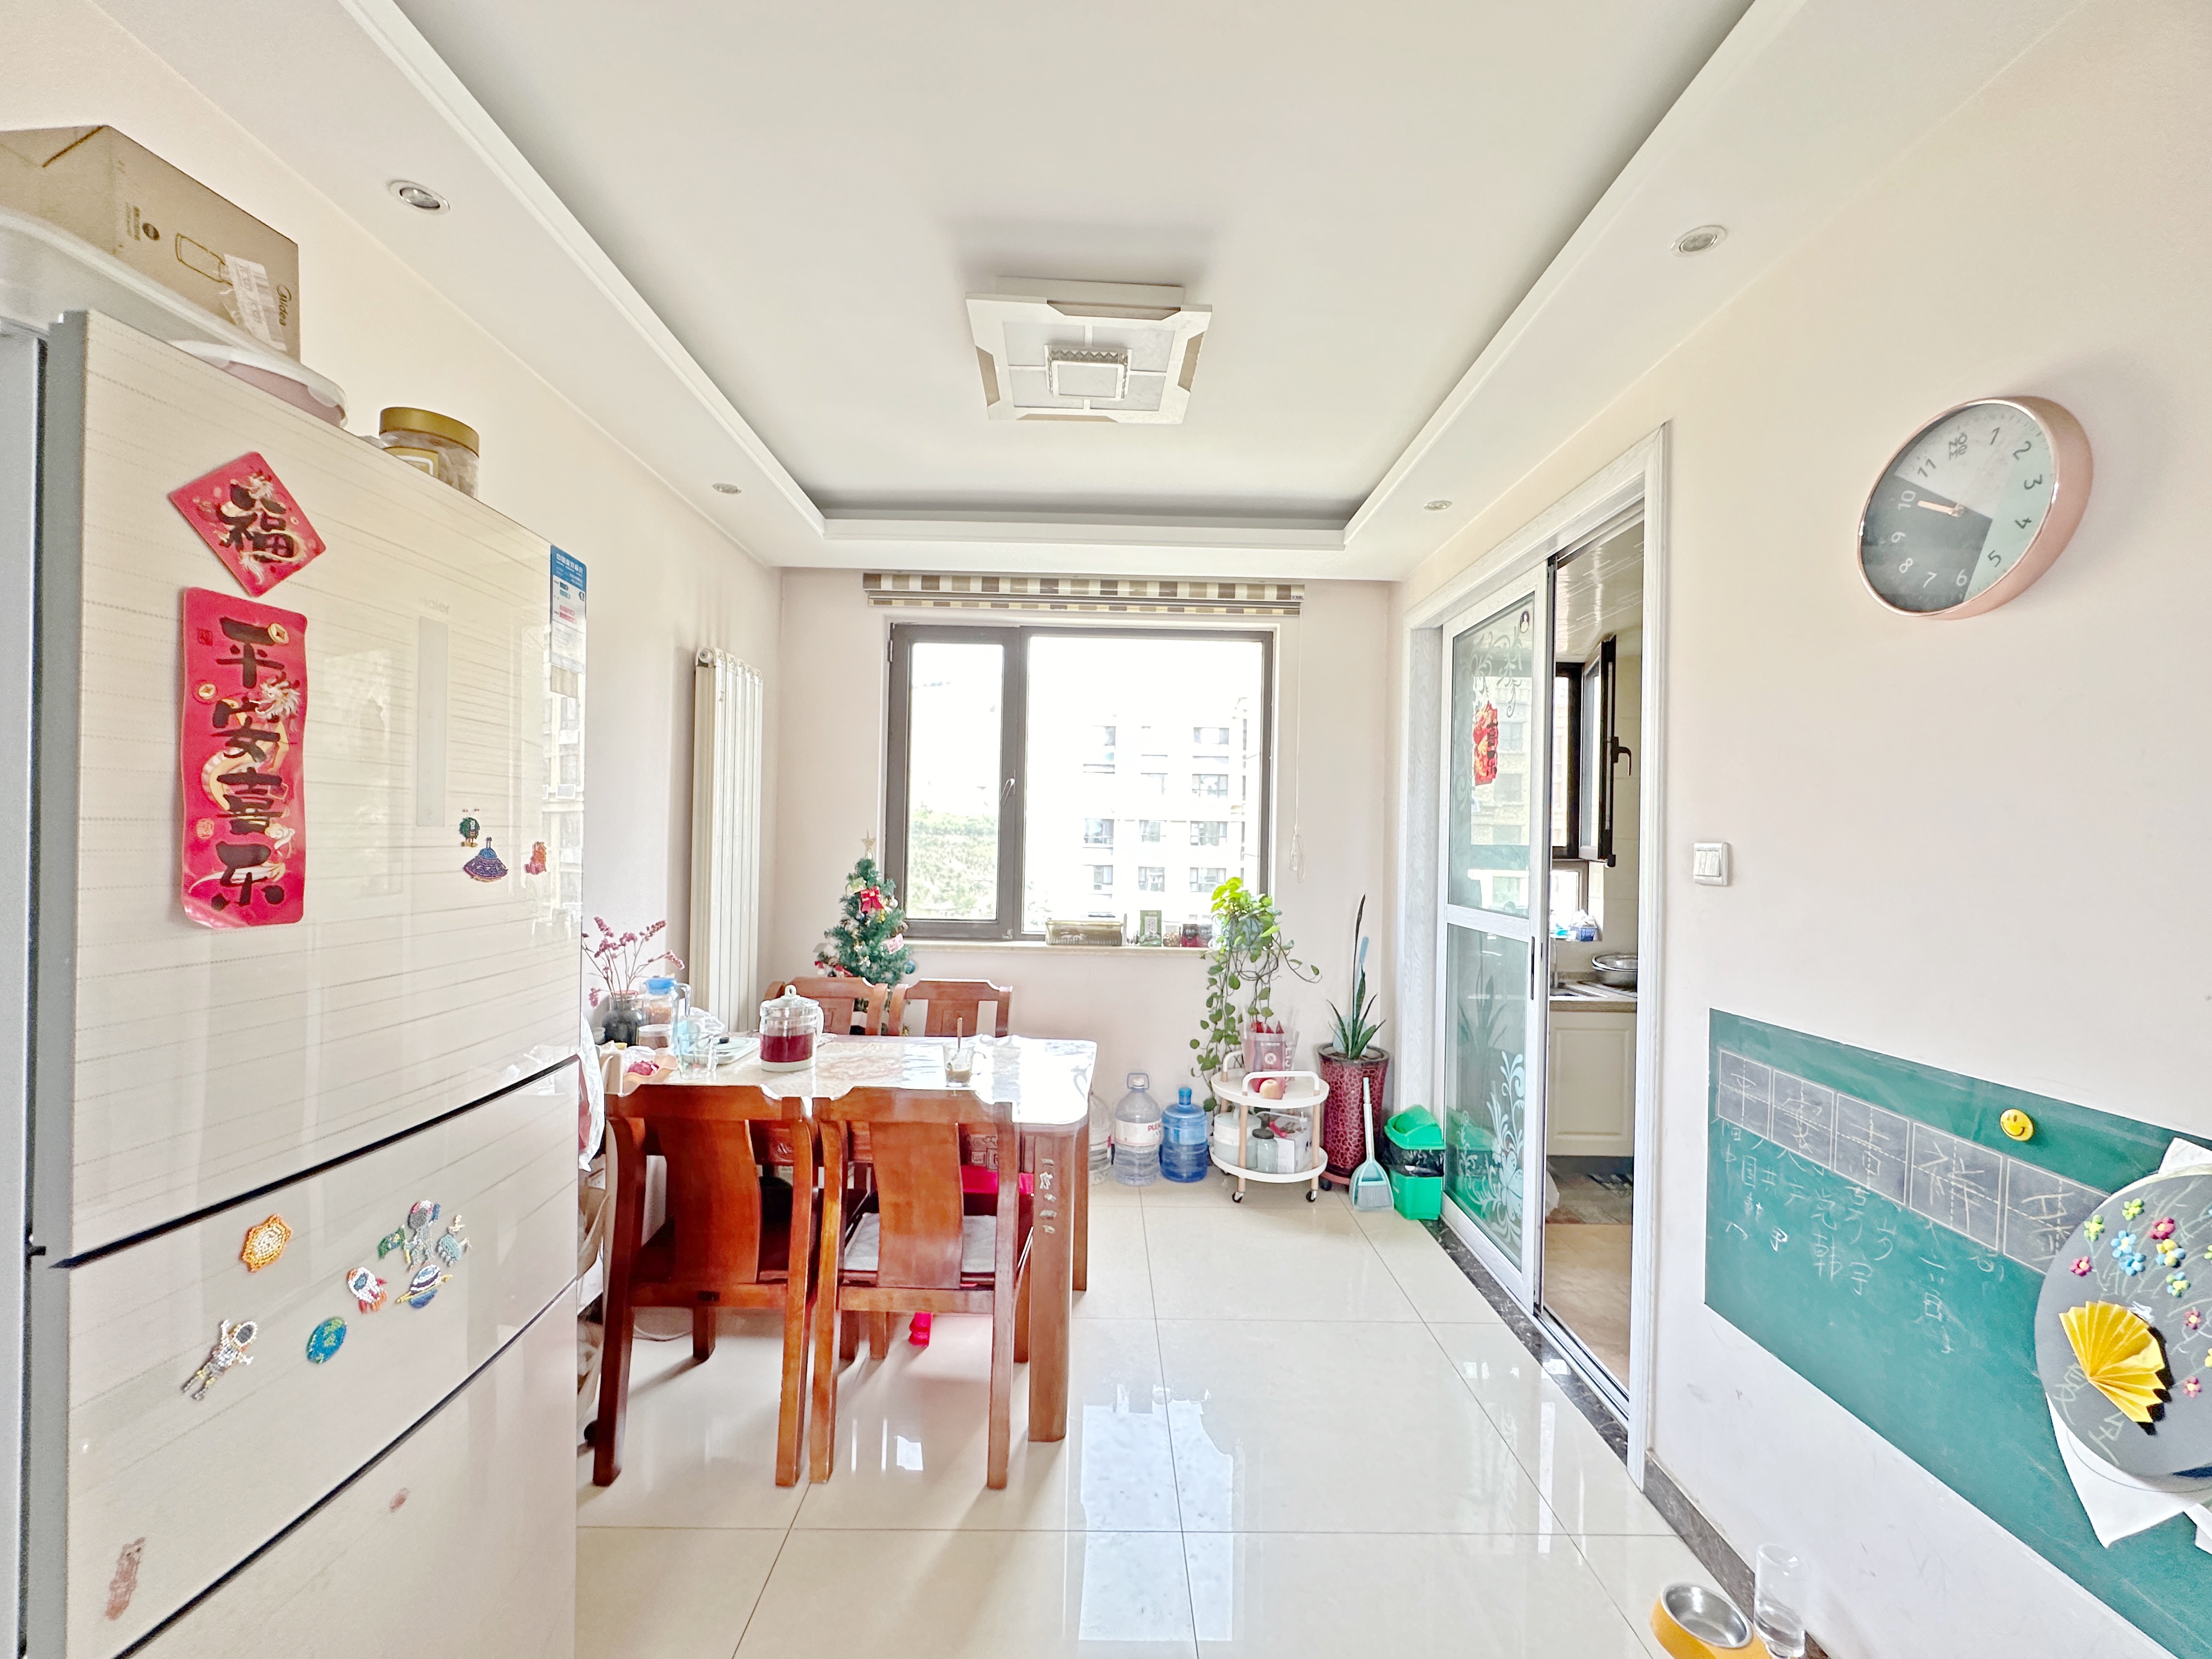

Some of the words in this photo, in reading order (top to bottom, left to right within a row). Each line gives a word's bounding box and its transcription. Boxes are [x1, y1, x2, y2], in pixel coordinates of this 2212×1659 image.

[276, 285, 292, 328] Midea
[1990, 427, 2001, 445] 1
[2013, 441, 2032, 460] 2
[1917, 458, 1937, 478] 11
[2024, 475, 2042, 490] 3
[1898, 490, 1916, 510] 10
[217, 483, 295, 563] 福
[2015, 517, 2032, 529] 4
[1891, 531, 1905, 543] 9
[1899, 558, 1913, 573] 8
[1988, 550, 2001, 567] 5
[1923, 572, 1937, 588] 7
[1956, 569, 1967, 587] 6
[211, 616, 286, 911] 平安喜乐
